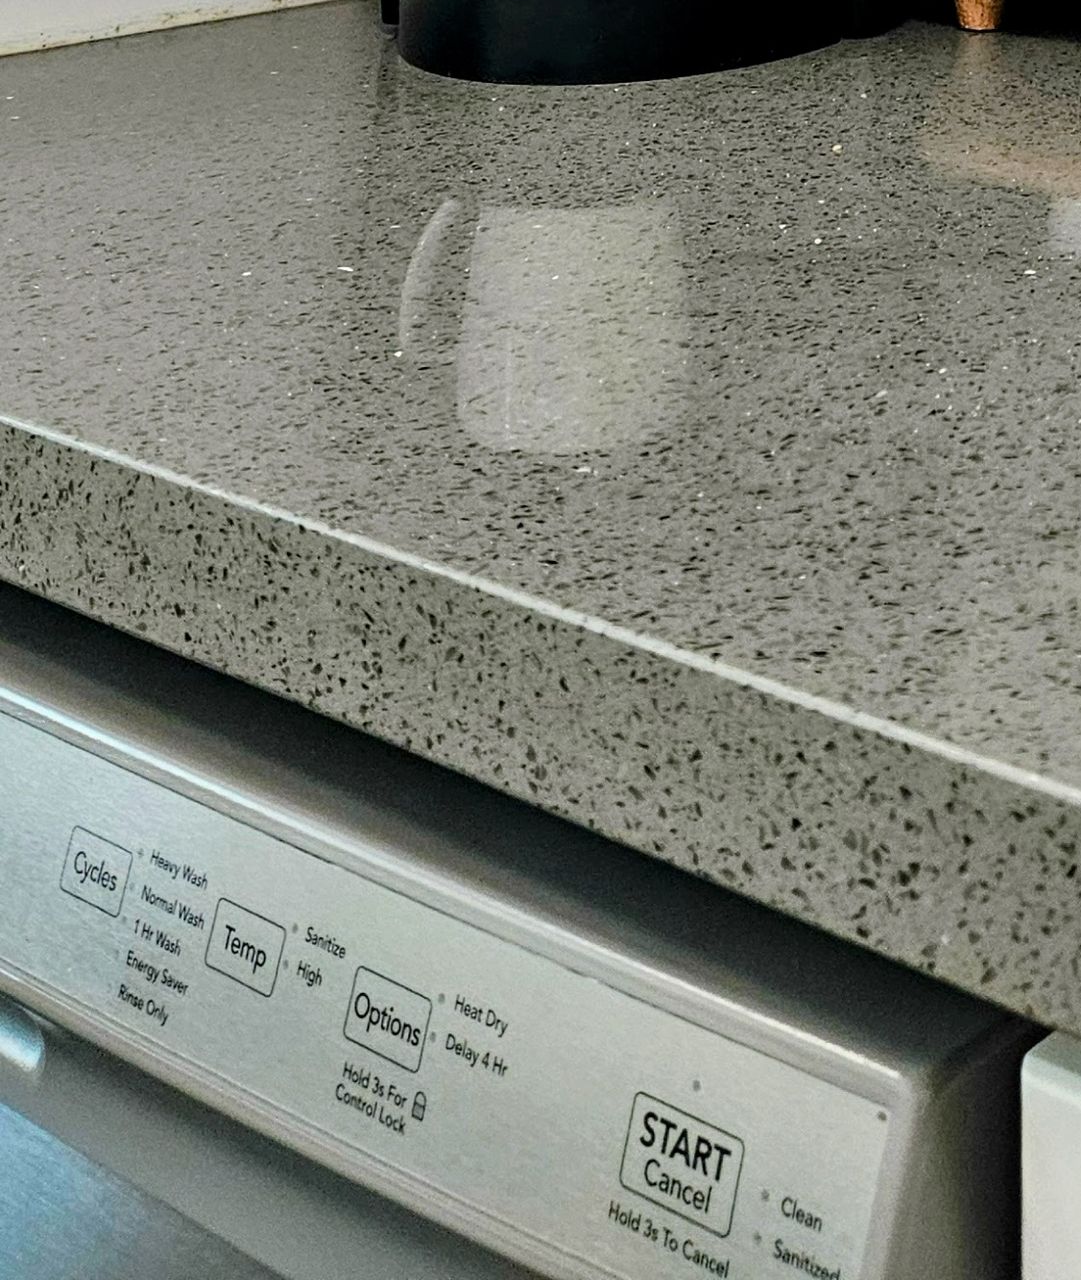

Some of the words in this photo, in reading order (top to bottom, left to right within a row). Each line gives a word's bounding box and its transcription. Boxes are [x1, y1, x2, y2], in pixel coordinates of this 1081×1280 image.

[73, 851, 118, 892] Cycles
[150, 849, 181, 881] Heavy
[182, 863, 209, 891] Wash
[141, 885, 178, 916] Normal
[178, 903, 205, 930] Wash
[134, 919, 141, 935] 1
[140, 923, 155, 940] Hr
[155, 931, 182, 957] Wash
[225, 924, 267, 975] Temp
[305, 926, 347, 959] Sanitize
[126, 950, 161, 985] Energy
[160, 968, 190, 996] Saver
[296, 960, 323, 987] High
[117, 983, 145, 1012] Rinse
[145, 999, 170, 1027] Only
[354, 992, 421, 1047] Options
[454, 994, 484, 1023] Heat
[485, 1009, 509, 1038] Dry
[445, 1033, 480, 1068] Delay
[481, 1052, 491, 1070] 4
[492, 1056, 509, 1078] Hr
[342, 1061, 371, 1090] Hold
[371, 1076, 386, 1098] 3s
[386, 1084, 408, 1109] For
[335, 1083, 378, 1120] Control
[378, 1106, 407, 1136] Lock
[639, 1111, 732, 1182] START
[643, 1158, 713, 1214] Cancel
[781, 1196, 823, 1233] Clean
[608, 1200, 641, 1233] Hold
[642, 1218, 659, 1243] 3s
[661, 1227, 680, 1253] To
[681, 1239, 731, 1279] Cancel
[773, 1238, 842, 1280] Sanitized
